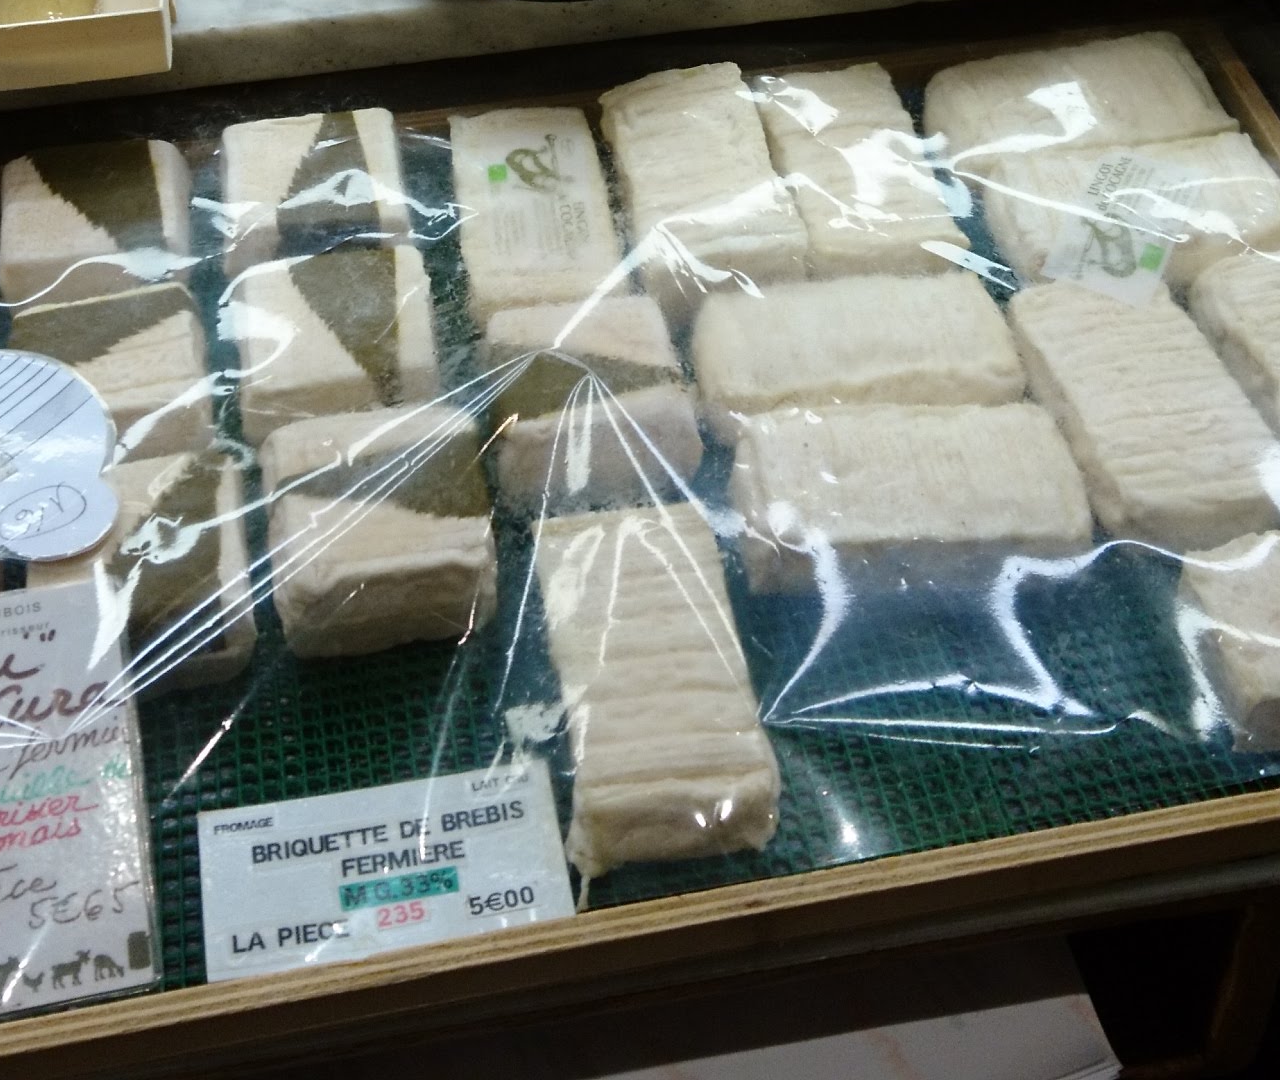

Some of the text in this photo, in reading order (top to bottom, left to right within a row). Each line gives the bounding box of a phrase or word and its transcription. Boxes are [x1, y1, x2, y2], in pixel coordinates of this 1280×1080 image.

[214, 816, 275, 836] FROMAGE
[251, 800, 526, 866] BRIQUETTE DE BREBIS
[340, 840, 466, 879] FERMIERE
[376, 901, 426, 928] 235
[468, 886, 536, 917] 5€00
[231, 920, 352, 955] LA PIECE
